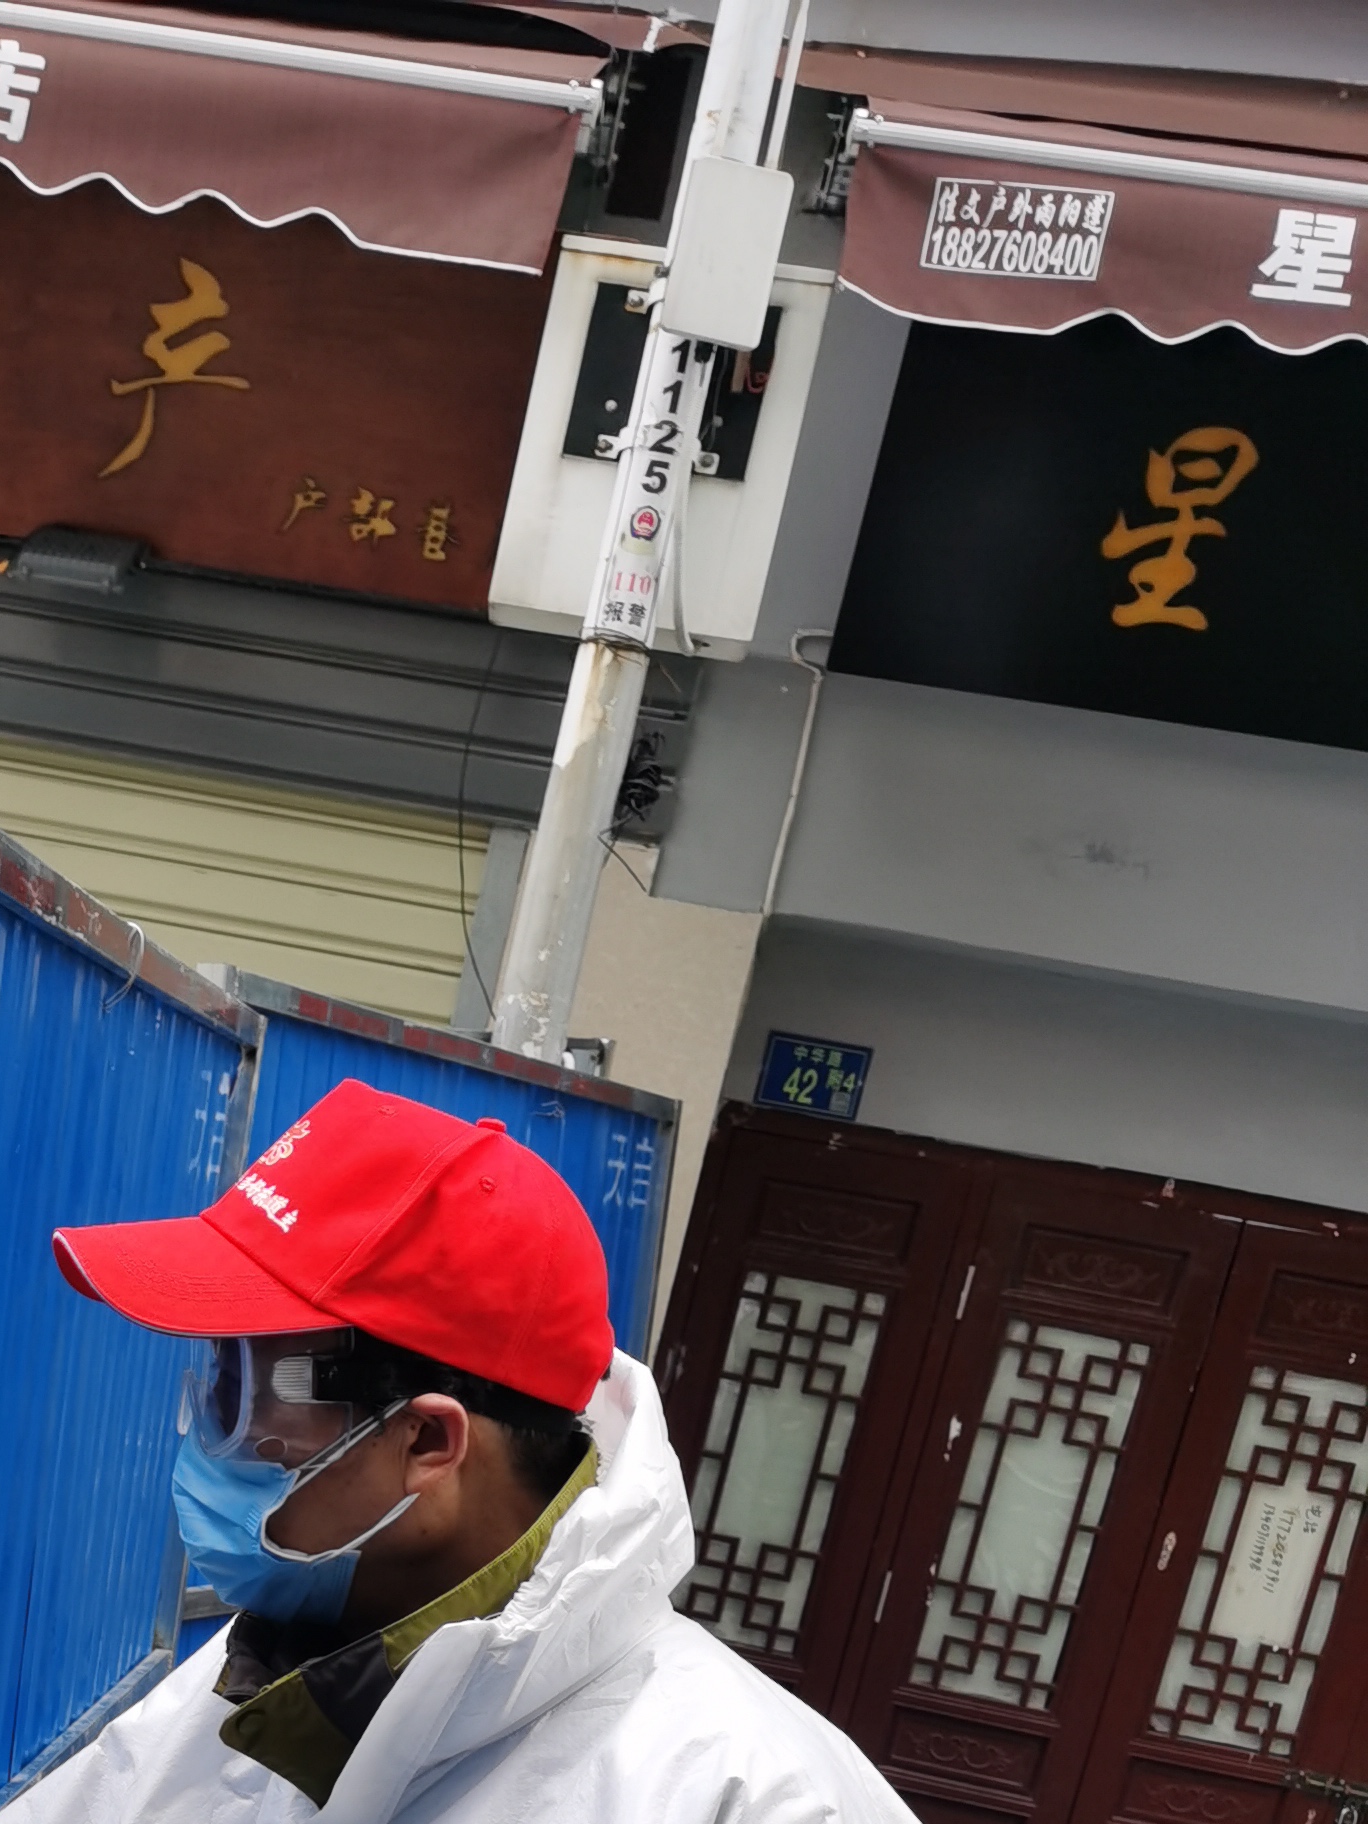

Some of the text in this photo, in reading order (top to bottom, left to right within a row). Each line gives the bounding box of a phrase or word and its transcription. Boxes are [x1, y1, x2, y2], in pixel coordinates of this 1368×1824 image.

[930, 225, 1099, 276] 18827608400
[1250, 208, 1359, 309] 星
[641, 338, 692, 495] 1125
[1099, 425, 1261, 632] 星
[612, 570, 652, 596] 110
[602, 602, 648, 629] 报警
[781, 1066, 819, 1105] 42
